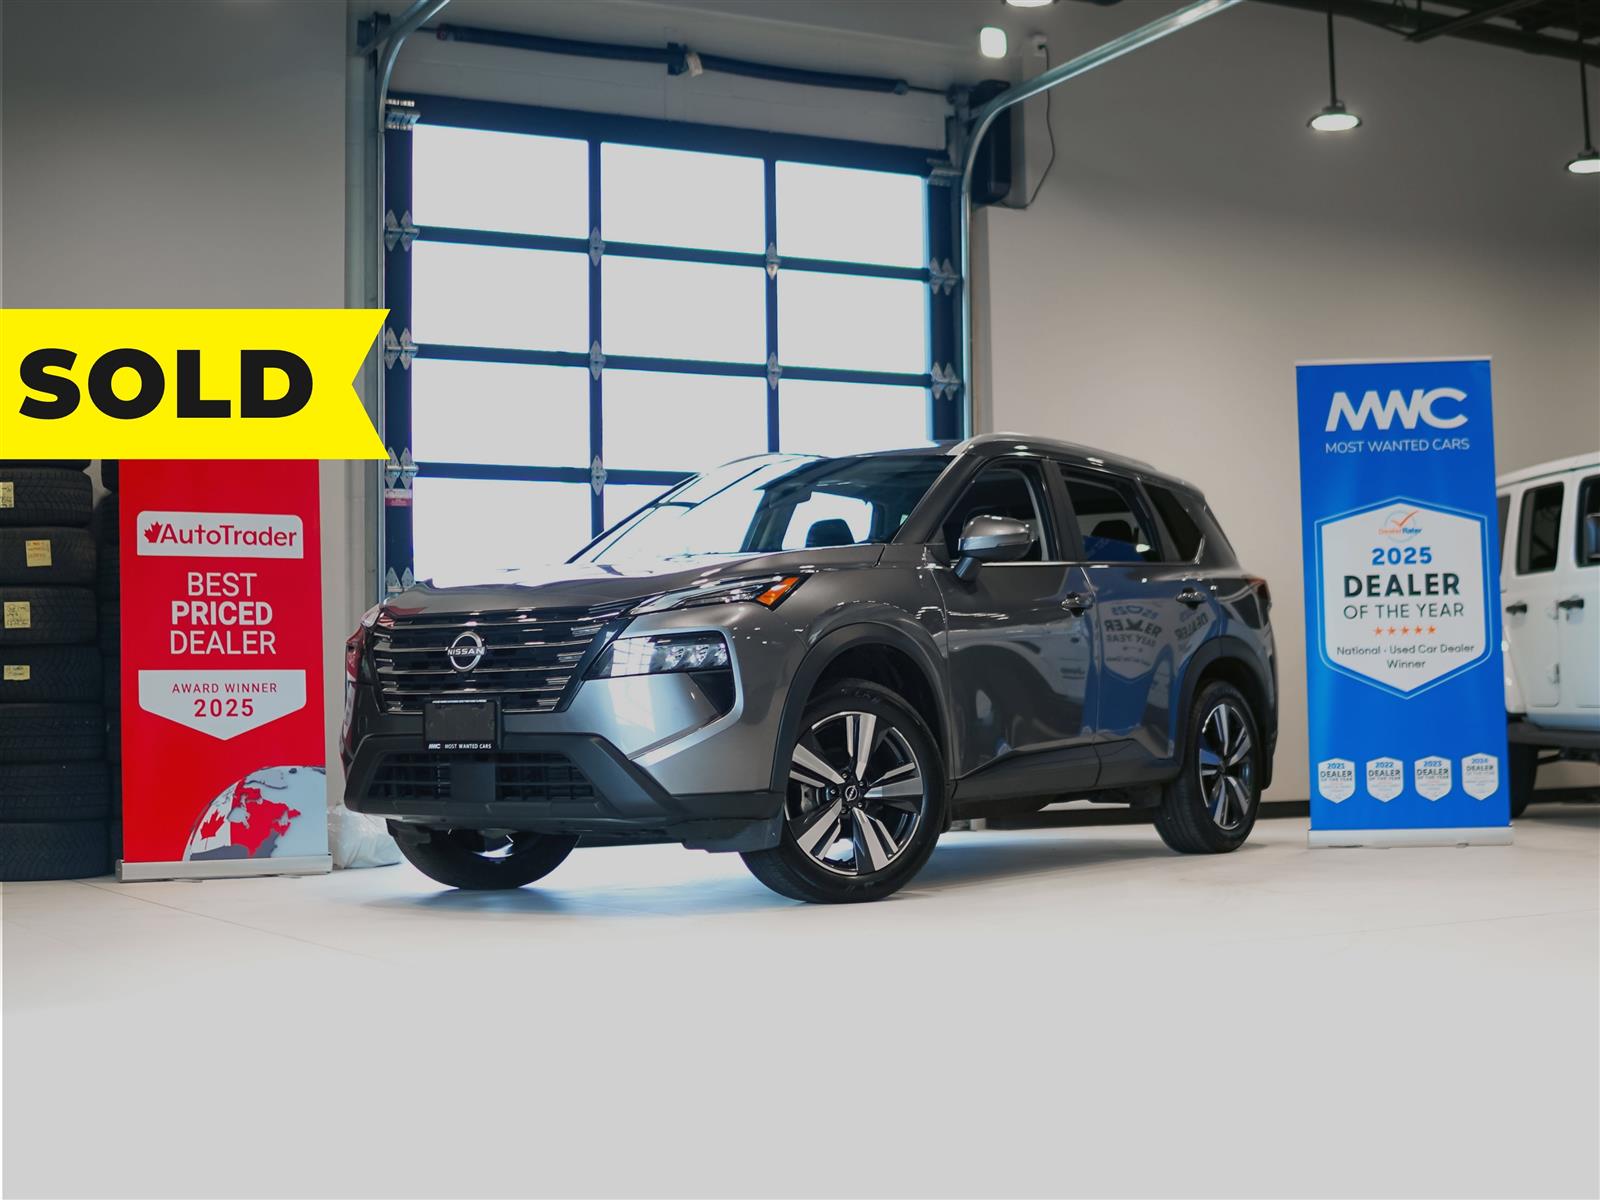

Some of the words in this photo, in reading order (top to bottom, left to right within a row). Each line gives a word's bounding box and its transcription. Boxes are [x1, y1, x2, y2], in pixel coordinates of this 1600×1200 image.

[1325, 387, 1468, 432] MWC
[1325, 441, 1365, 454] MOST
[1368, 439, 1429, 452] WANTED
[1432, 438, 1470, 450] CARS
[160, 523, 297, 547] AutoTrader
[1371, 547, 1433, 566] 2025
[187, 572, 258, 597] BEST
[1343, 573, 1460, 598] DEALER
[171, 600, 273, 626] PRICED
[1343, 604, 1369, 620] OF
[1375, 603, 1410, 618] THE
[1416, 602, 1465, 618] YEAR
[170, 630, 276, 655] DEALER
[447, 647, 485, 656] NISSAN
[1336, 645, 1381, 656] National
[1389, 645, 1416, 655] Used
[1418, 645, 1437, 655] Car
[1440, 643, 1475, 654] Dealer
[1386, 659, 1426, 669] Winner
[172, 683, 219, 693] AWARD
[225, 683, 278, 693] WINNER
[194, 699, 254, 717] 2025
